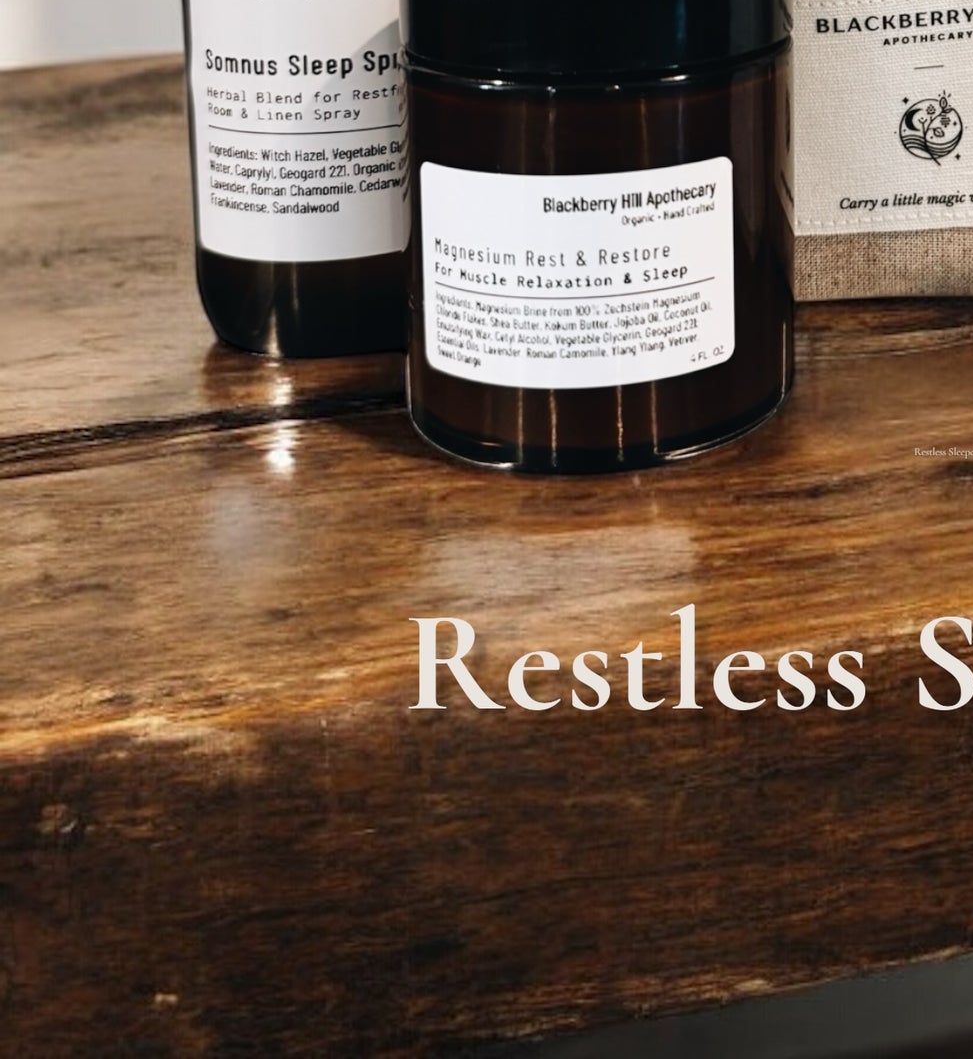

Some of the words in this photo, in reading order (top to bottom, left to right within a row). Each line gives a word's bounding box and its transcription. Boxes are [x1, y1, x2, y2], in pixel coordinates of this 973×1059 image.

[883, 30, 973, 46] APOTHECARY
[205, 49, 278, 76] Somnus
[288, 54, 353, 79] Sleep
[206, 87, 247, 102] Herbal
[256, 92, 302, 104] Blend
[314, 91, 341, 103] for
[352, 84, 400, 100] Restf
[207, 103, 233, 117] Room
[241, 108, 248, 119] &
[257, 108, 302, 121] Linen
[314, 108, 361, 122] Spray
[261, 149, 291, 161] Witch
[332, 143, 387, 162] Vegetable
[279, 166, 326, 182] Geogard
[353, 159, 396, 177] Organic
[251, 182, 286, 196] Roman
[359, 177, 401, 192] Cedarw
[272, 200, 340, 214] Sandalwood
[543, 197, 617, 214] Blackberry
[621, 191, 642, 209] Hill
[646, 182, 717, 209] Apothecary
[839, 196, 878, 211] Carry
[881, 197, 889, 207] a
[892, 192, 924, 206] little
[926, 190, 966, 208] magic
[621, 213, 655, 227] Organic
[663, 208, 685, 220] Hand
[434, 237, 516, 267] Magnesium
[526, 249, 565, 268] Rest
[576, 250, 587, 267] &
[599, 244, 671, 267] Restore
[434, 261, 453, 276] For
[459, 268, 507, 287] Muscle
[517, 274, 613, 289] Relaxation
[623, 273, 632, 285] &
[643, 264, 688, 283] Sleep
[549, 306, 573, 317] from
[614, 314, 646, 329] Jojoba
[555, 333, 601, 347] Vegetable
